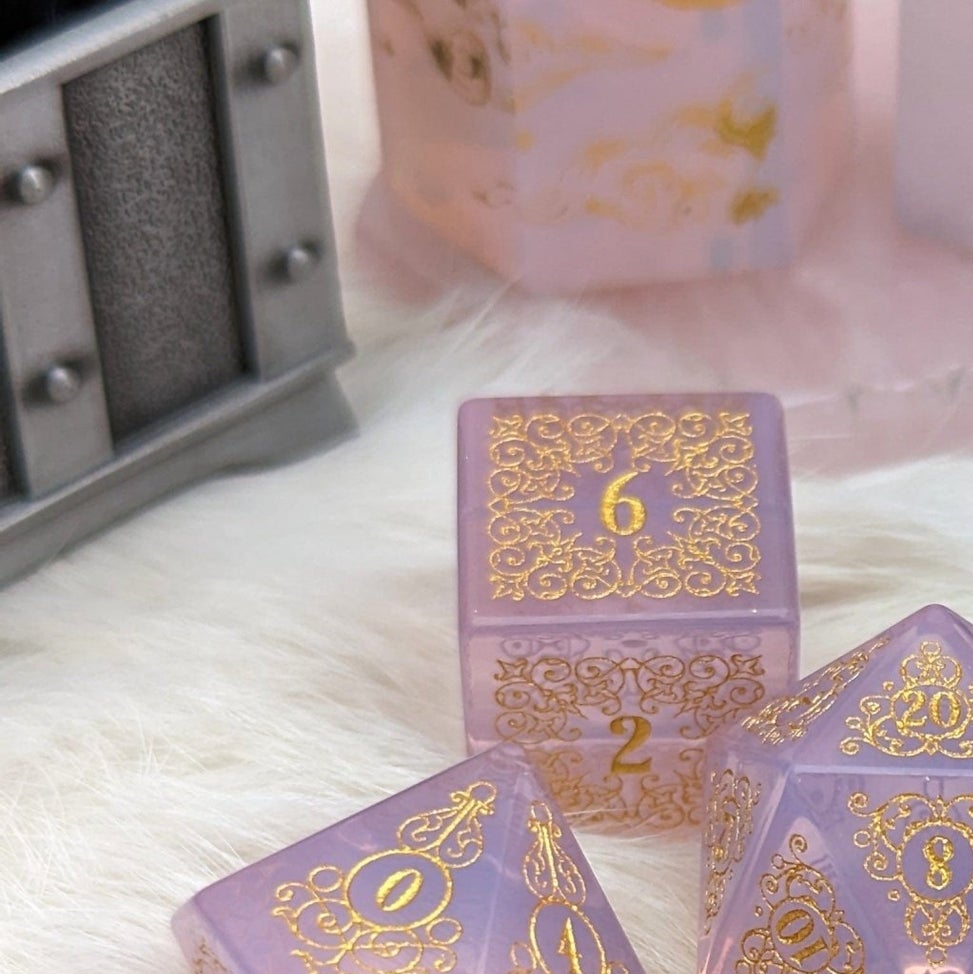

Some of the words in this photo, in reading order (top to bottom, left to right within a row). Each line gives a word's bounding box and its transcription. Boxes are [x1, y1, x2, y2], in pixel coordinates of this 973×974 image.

[601, 471, 647, 537] 6
[899, 690, 960, 728] 20
[609, 715, 653, 774] 2
[375, 868, 424, 911] 0
[922, 836, 955, 890] 8
[775, 909, 827, 968] 10
